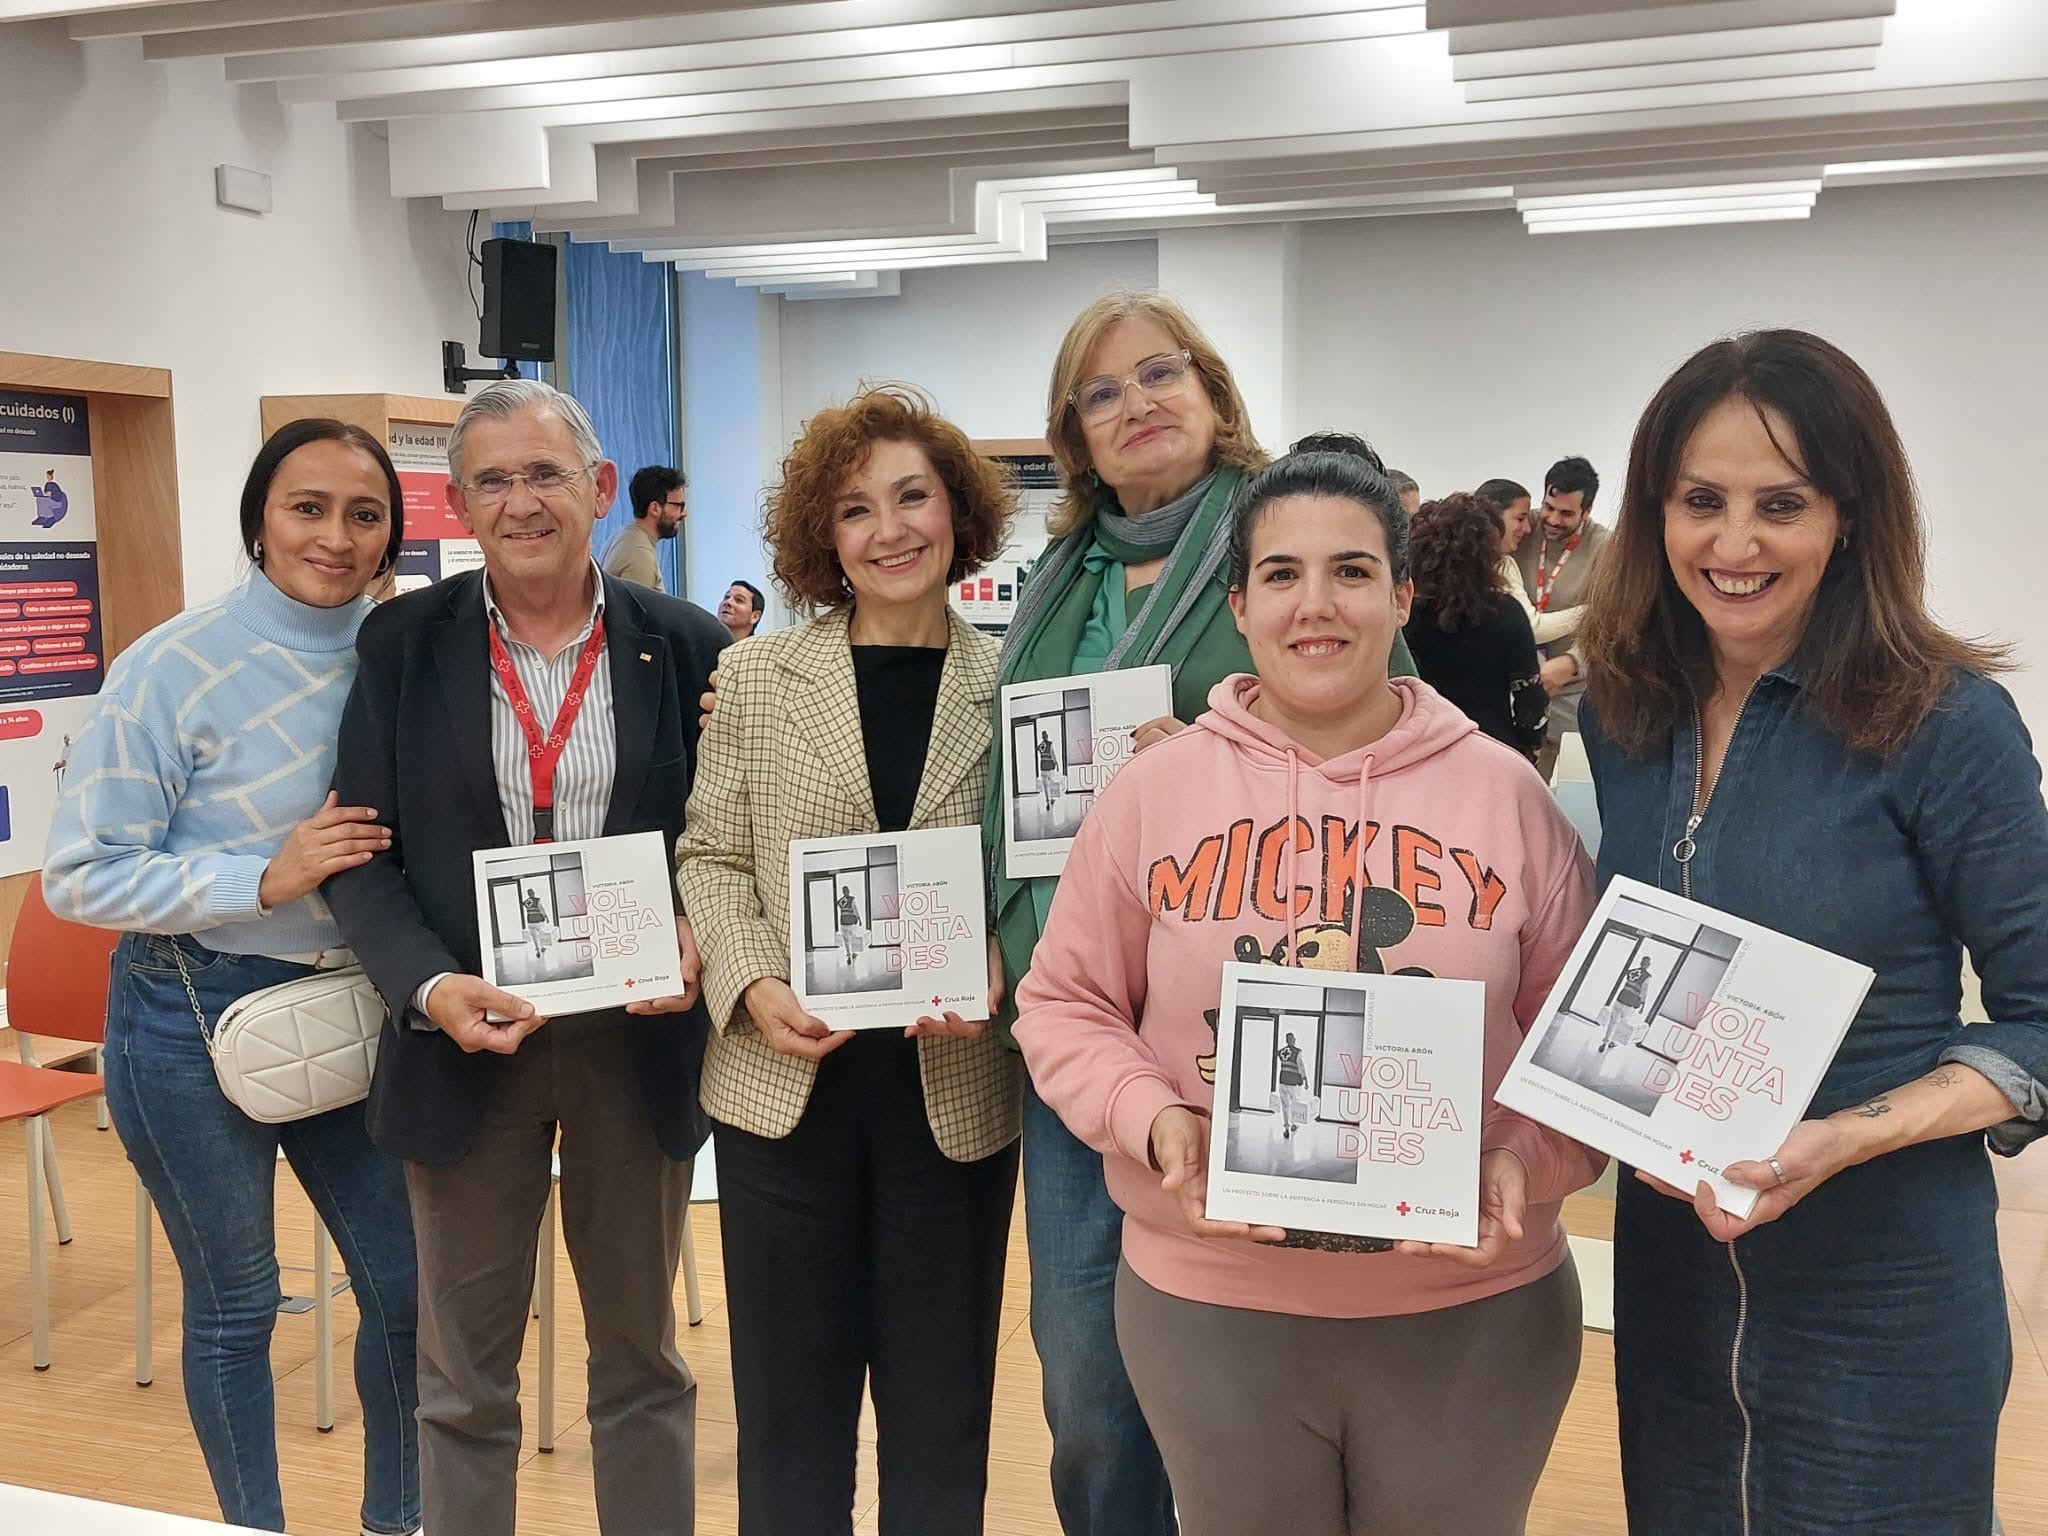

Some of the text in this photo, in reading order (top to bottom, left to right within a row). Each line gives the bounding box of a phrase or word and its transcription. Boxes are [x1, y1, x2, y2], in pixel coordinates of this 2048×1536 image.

[0, 402, 75, 424] cuidados (I)
[399, 435, 404, 447] y
[405, 433, 413, 445] la
[415, 435, 435, 446] edad
[1023, 462, 1046, 471] edad
[15, 552, 23, 560] de
[24, 552, 30, 560] la
[31, 551, 56, 560] soledad
[65, 551, 91, 560] deseada
[1077, 735, 1133, 762] VOL
[1147, 813, 1507, 931] MICKEY
[568, 888, 637, 915] VOL
[881, 890, 949, 918] VOL
[572, 907, 663, 938] UNTA
[884, 915, 973, 944] UNTA
[575, 934, 640, 963] DES
[885, 944, 949, 974] DES
[944, 994, 976, 1003] Cruz Roja
[1726, 993, 1762, 1012] VICTORIA
[1685, 992, 1770, 1056] VOL
[1374, 1044, 1409, 1053] VICTORIA
[1339, 1053, 1431, 1092] VOL
[1663, 1025, 1784, 1105] UNTA
[1641, 1059, 1739, 1122] DES
[1338, 1090, 1463, 1132] UNTA
[1336, 1126, 1425, 1166] DES
[1697, 1159, 1720, 1175] Cruz
[1415, 1206, 1460, 1219] Cruz Roja
